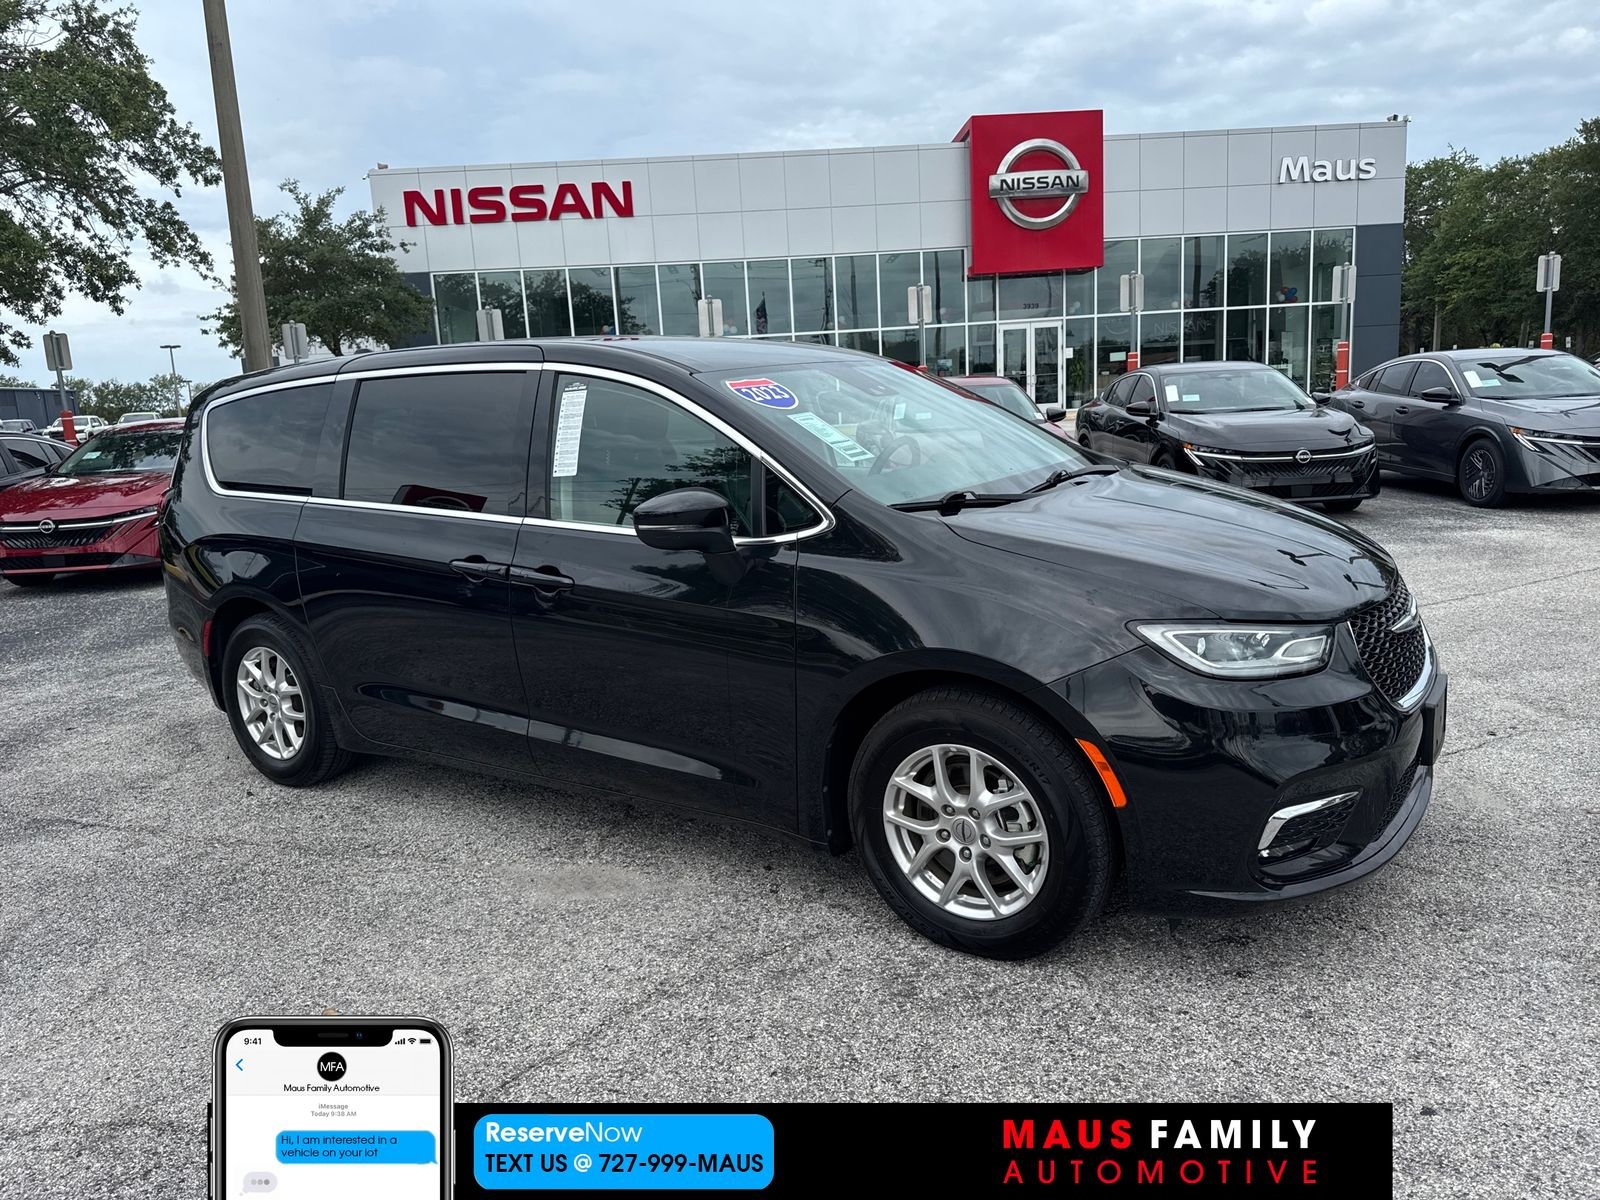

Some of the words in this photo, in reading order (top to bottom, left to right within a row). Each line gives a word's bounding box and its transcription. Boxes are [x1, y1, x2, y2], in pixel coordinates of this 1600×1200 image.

[1278, 155, 1377, 184] Maus
[1000, 174, 1080, 192] NISSAN
[403, 180, 634, 228] NISSAN
[740, 385, 790, 402] 2023
